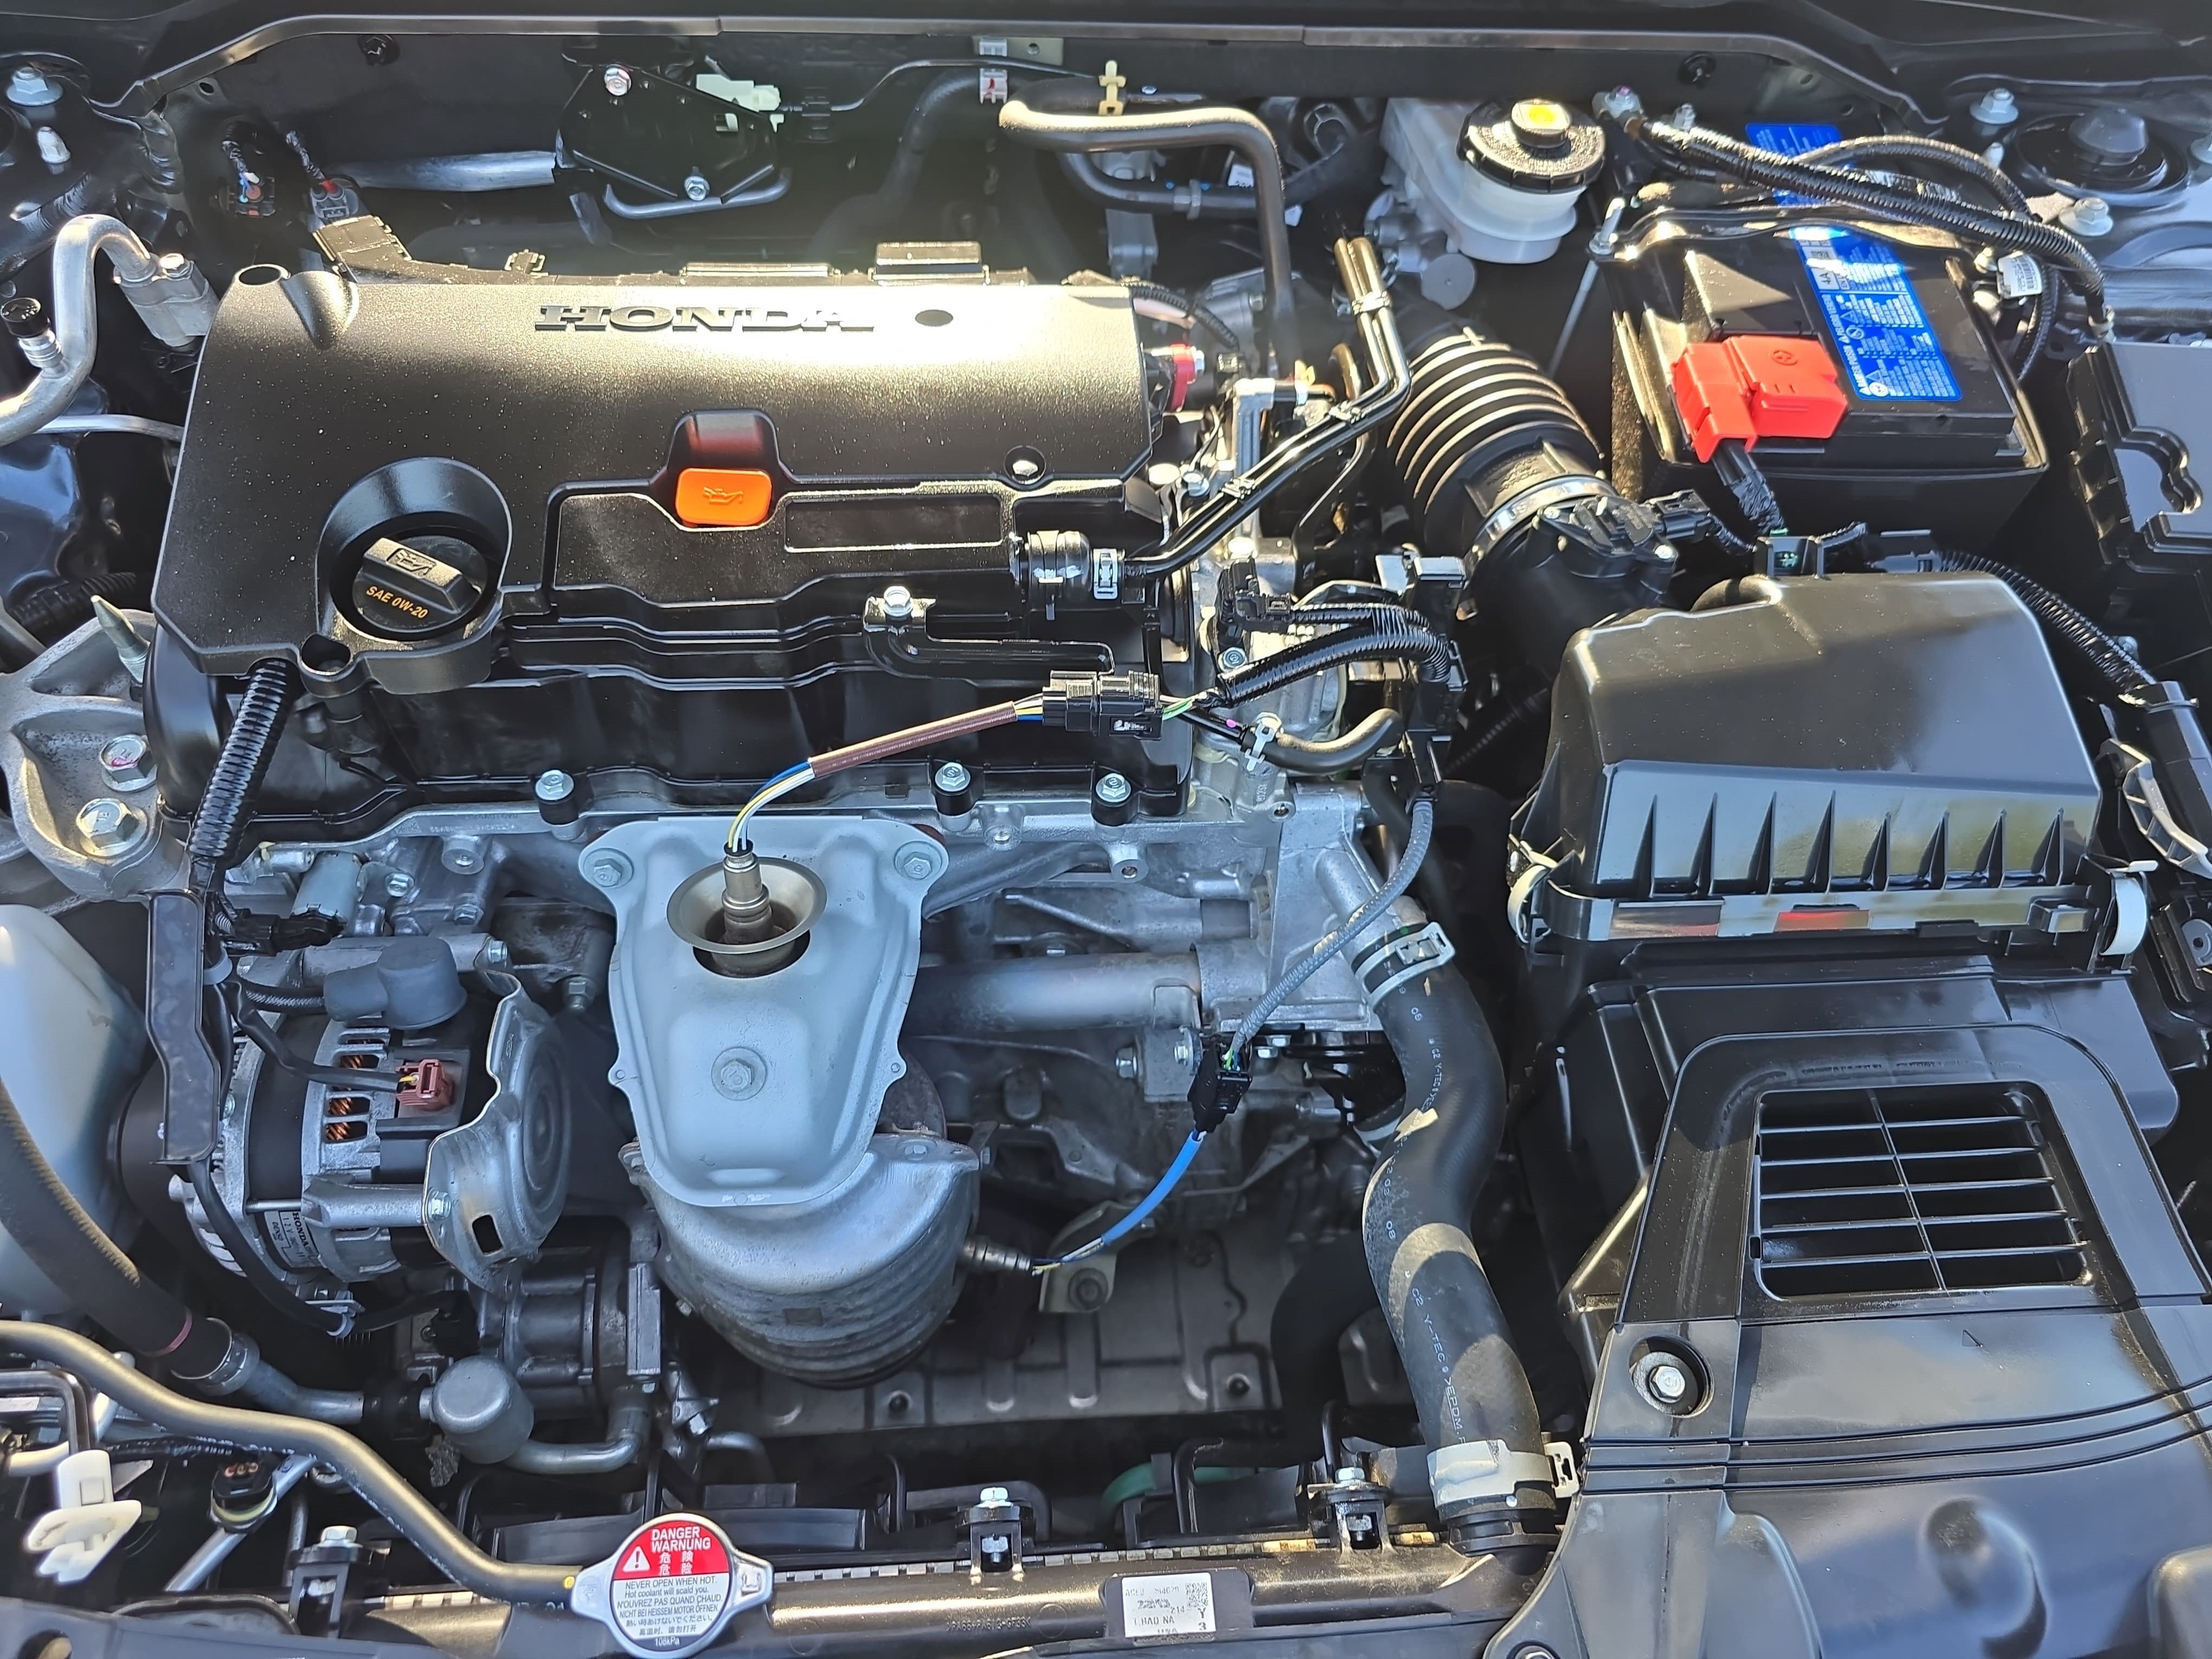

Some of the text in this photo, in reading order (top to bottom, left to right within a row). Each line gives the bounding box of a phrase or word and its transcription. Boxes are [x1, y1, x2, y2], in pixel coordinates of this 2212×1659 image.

[535, 305, 874, 332] HONDA
[365, 586, 429, 619] SAE 0W-20
[292, 1212, 309, 1246] HONDA
[1411, 1287, 1423, 1307] C2
[1423, 1314, 1446, 1362] Y-TEC
[651, 1526, 700, 1541] DANGER
[651, 1537, 711, 1553] WARNUNG
[625, 1576, 717, 1590] NEVER OPEN WHEN HOT.
[625, 1590, 636, 1598] Hot
[638, 1589, 662, 1597] coolant
[676, 1586, 693, 1594] scald
[695, 1586, 709, 1595] you.
[617, 1594, 723, 1609] N'OUVREZ PAS QUAND CHAUD.
[620, 1610, 636, 1618] NICHT
[638, 1609, 647, 1617] BEI
[648, 1606, 672, 1616] HEISSEM
[673, 1605, 694, 1615] MOTOR
[1198, 1607, 1206, 1619] Y
[1198, 1622, 1207, 1631] 3
[654, 1636, 680, 1647] 108kPa
